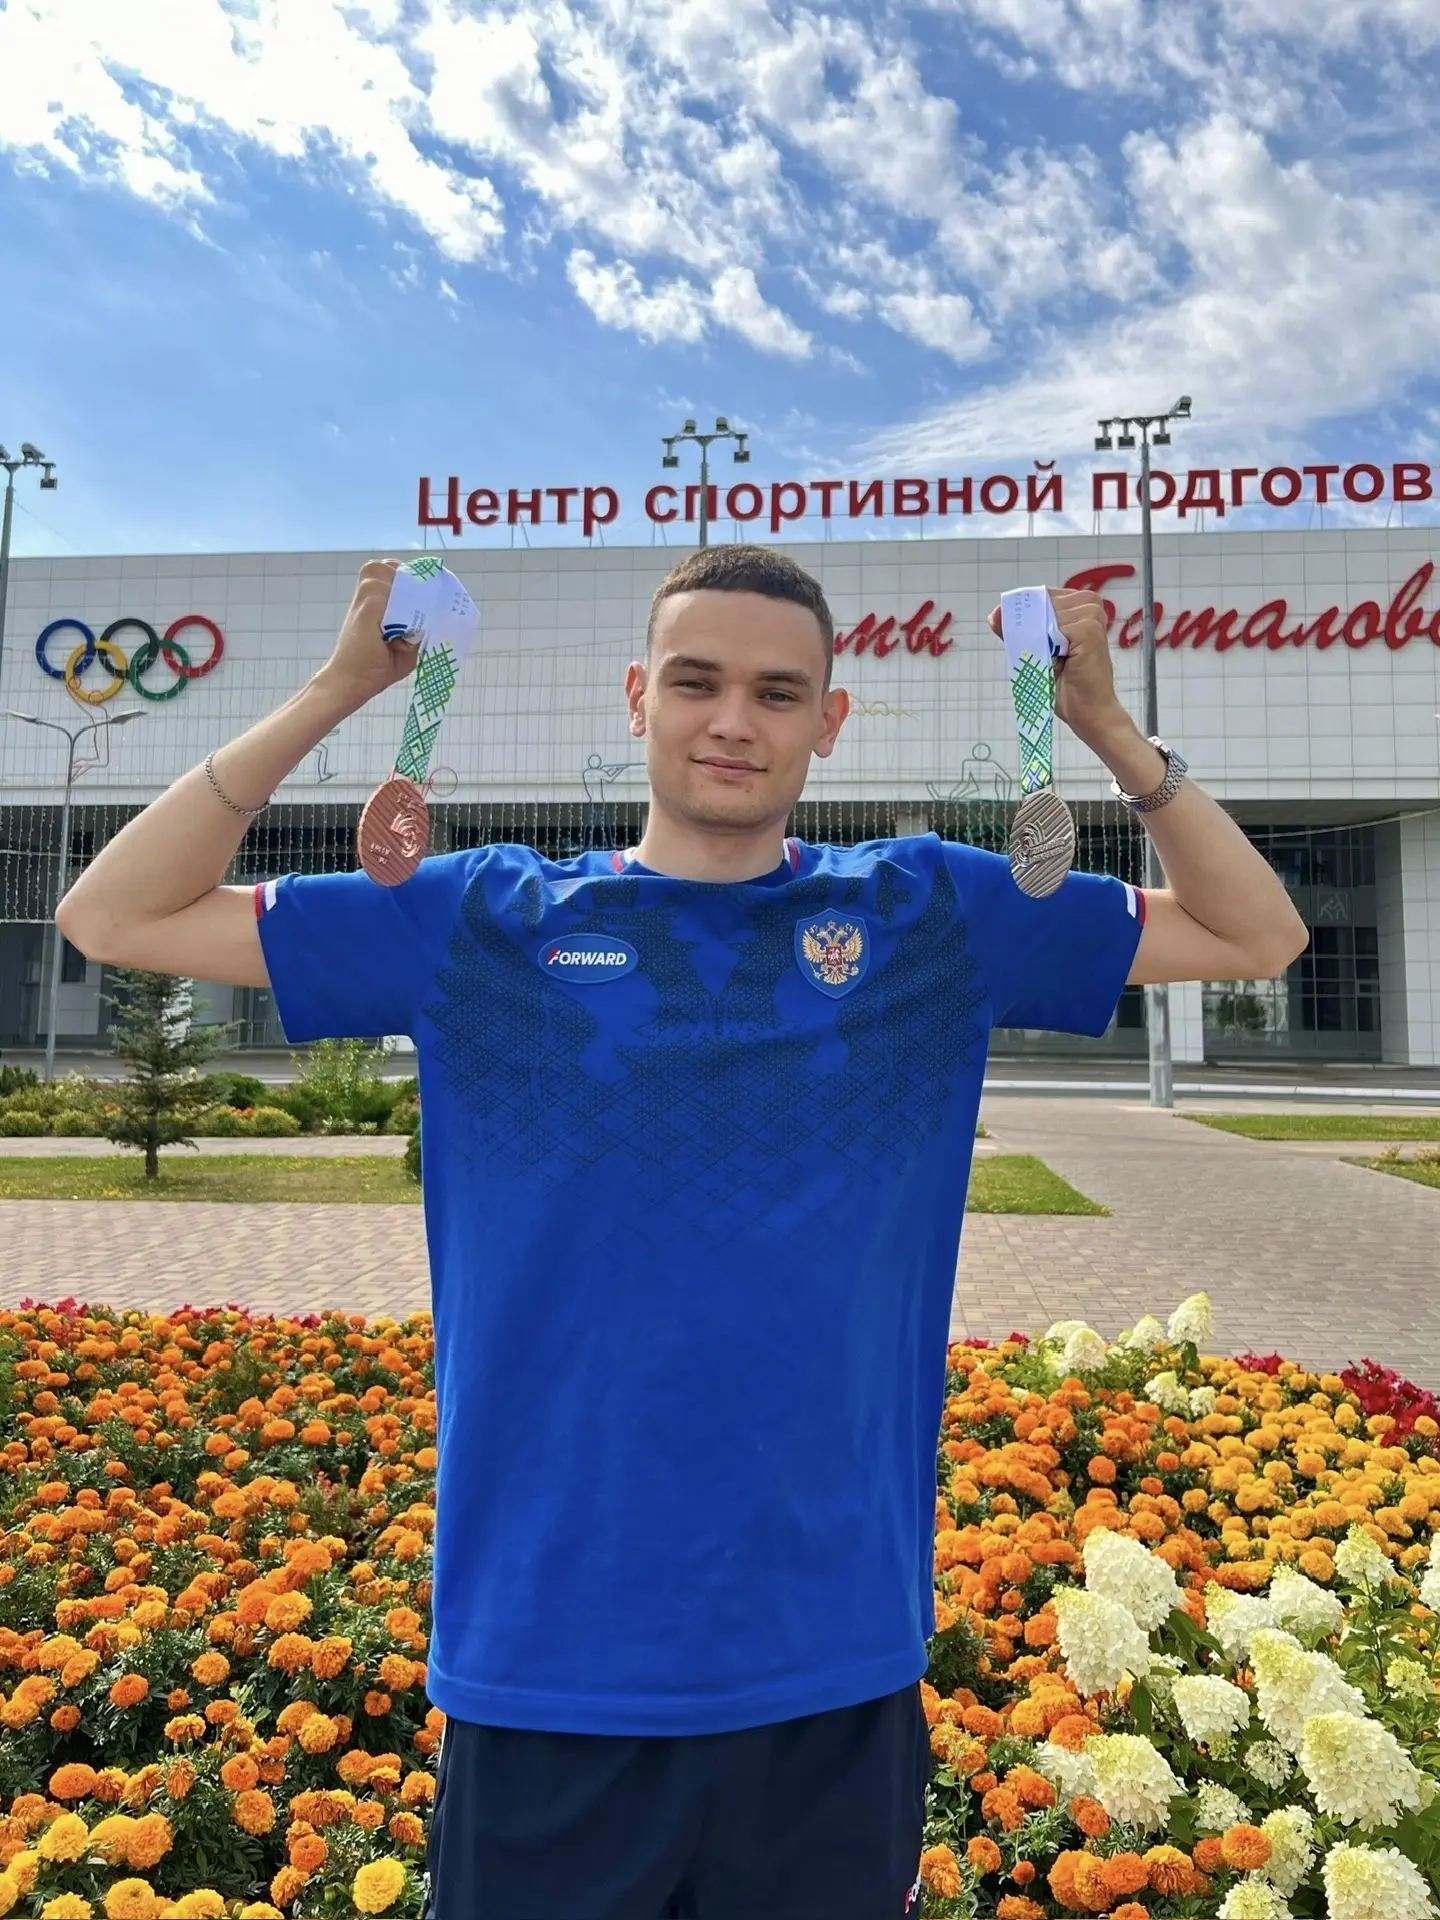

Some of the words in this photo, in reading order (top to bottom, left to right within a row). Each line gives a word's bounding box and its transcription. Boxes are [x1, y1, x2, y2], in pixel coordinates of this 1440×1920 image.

[418, 476, 618, 536] Центр
[645, 460, 1063, 533] спортивной
[1093, 463, 1433, 518] подготов
[833, 600, 954, 658] мы
[1063, 562, 1440, 651] Баталов
[548, 948, 628, 966] FORWARD
